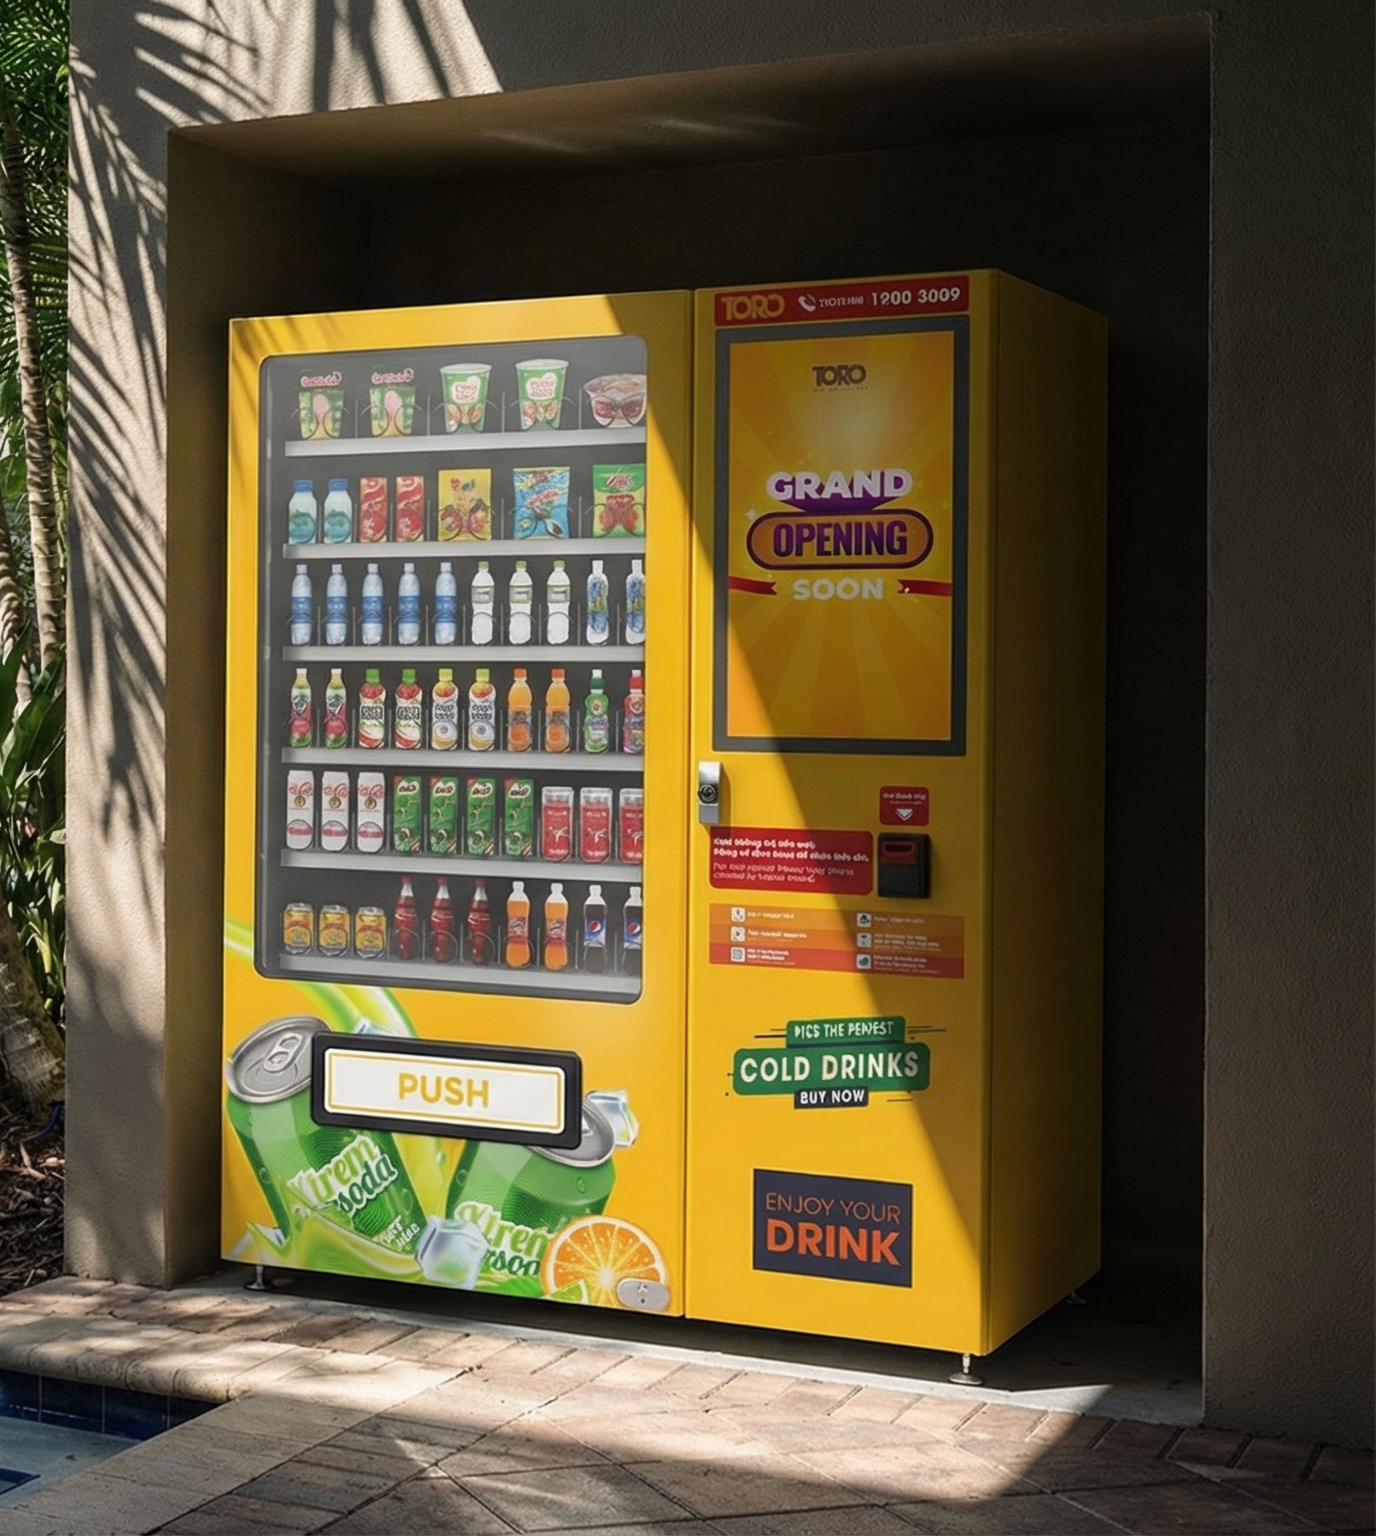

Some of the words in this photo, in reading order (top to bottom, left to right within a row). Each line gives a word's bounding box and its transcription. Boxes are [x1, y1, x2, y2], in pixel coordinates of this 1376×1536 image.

[721, 293, 785, 321] TORO
[917, 287, 961, 304] 3009
[812, 363, 867, 387] TORO
[765, 467, 914, 500] GRAND
[772, 520, 908, 558] OPENING
[791, 577, 884, 601] SOON
[823, 1023, 845, 1037] THE
[740, 1055, 811, 1083] COLD
[821, 1051, 919, 1080] DRINKS
[398, 1072, 490, 1110] PUSH
[800, 1090, 827, 1105] BUY
[831, 1089, 865, 1103] NOW
[336, 1155, 397, 1214] soda
[765, 1192, 835, 1216] ENJOY
[839, 1200, 901, 1225] YOUR
[767, 1218, 901, 1266] DRINK
